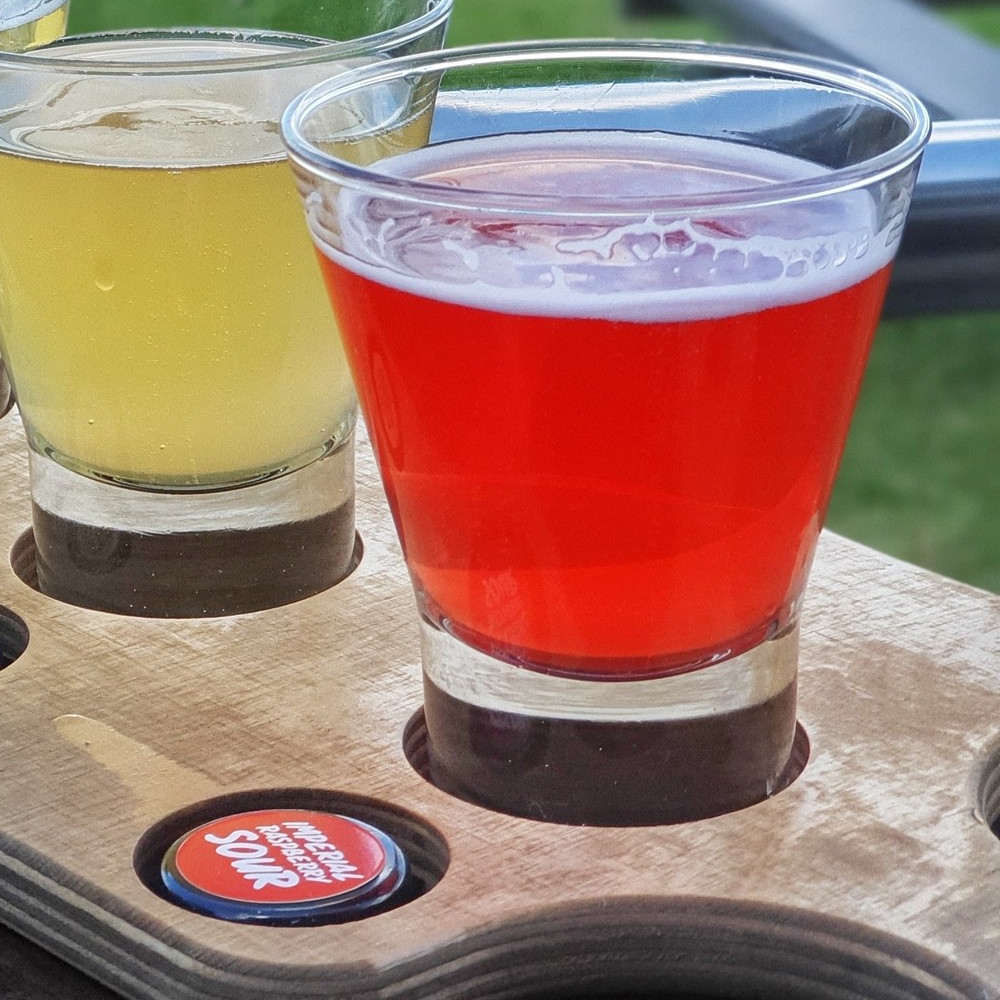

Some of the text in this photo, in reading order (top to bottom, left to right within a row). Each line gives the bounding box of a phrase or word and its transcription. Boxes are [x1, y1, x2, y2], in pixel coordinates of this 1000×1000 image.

[204, 829, 300, 890] SOUR
[255, 824, 333, 884] RASPBERRY
[282, 822, 364, 881] IMPERIAL
